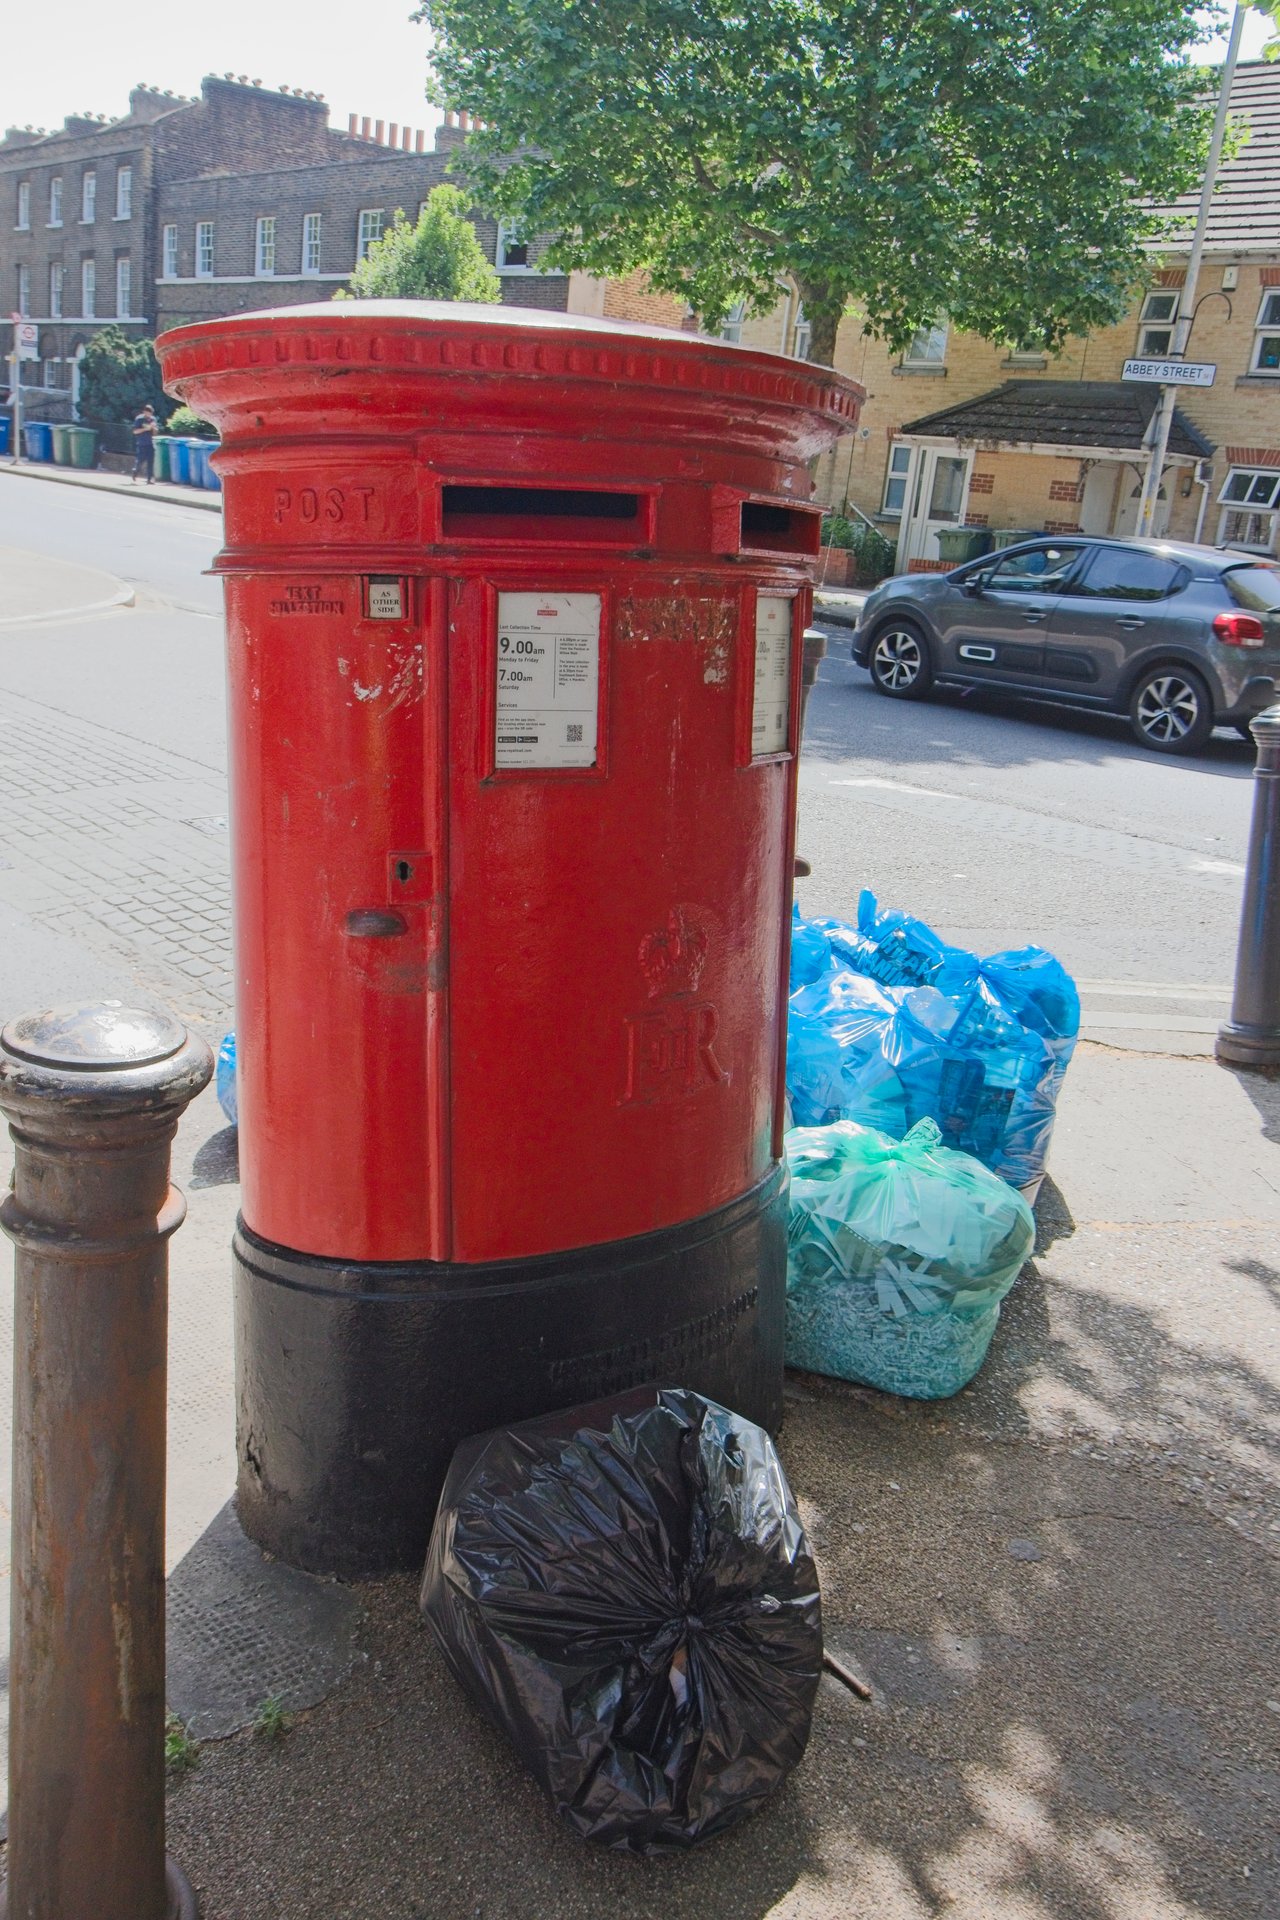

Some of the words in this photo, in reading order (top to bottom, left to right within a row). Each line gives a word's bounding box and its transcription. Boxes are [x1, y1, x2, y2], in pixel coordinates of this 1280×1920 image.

[1125, 364, 1160, 375] ABBEY
[1162, 366, 1203, 378] STREET
[274, 488, 375, 523] POST
[500, 637, 545, 655] 9.00am
[499, 669, 533, 682] 7.00am
